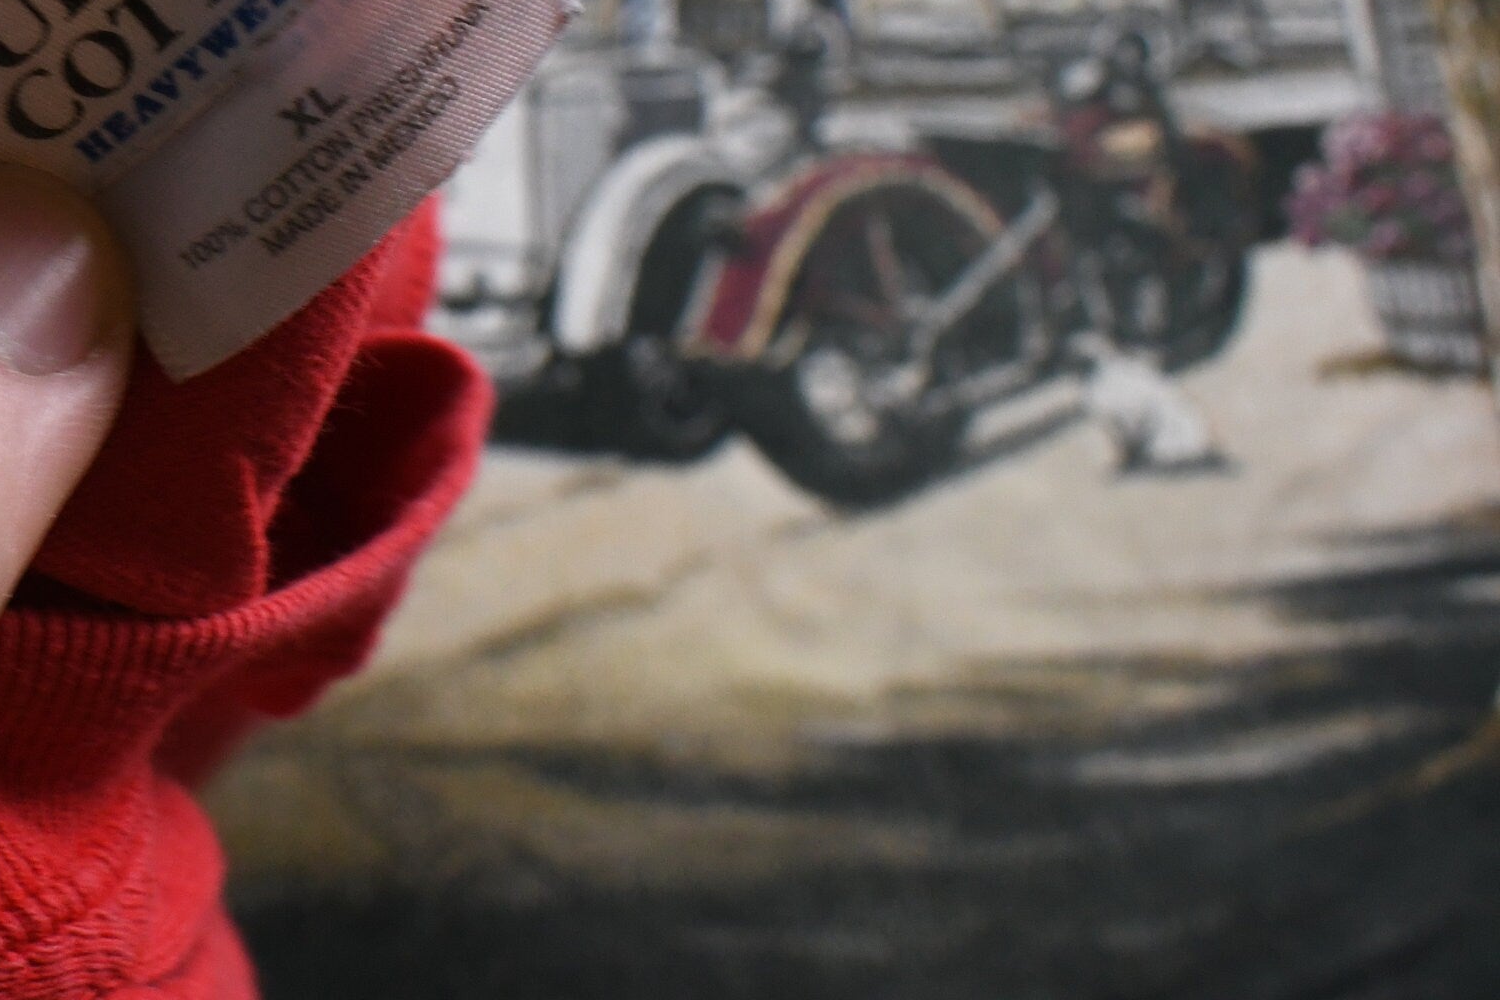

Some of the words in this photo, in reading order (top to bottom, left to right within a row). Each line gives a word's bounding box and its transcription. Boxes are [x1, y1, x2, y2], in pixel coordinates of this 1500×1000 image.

[258, 187, 342, 255] MADE
[337, 160, 372, 196] IN
[364, 75, 460, 170] MEXICO
[280, 87, 348, 140] XL
[181, 220, 249, 269] 100%
[242, 129, 353, 225] COTTON
